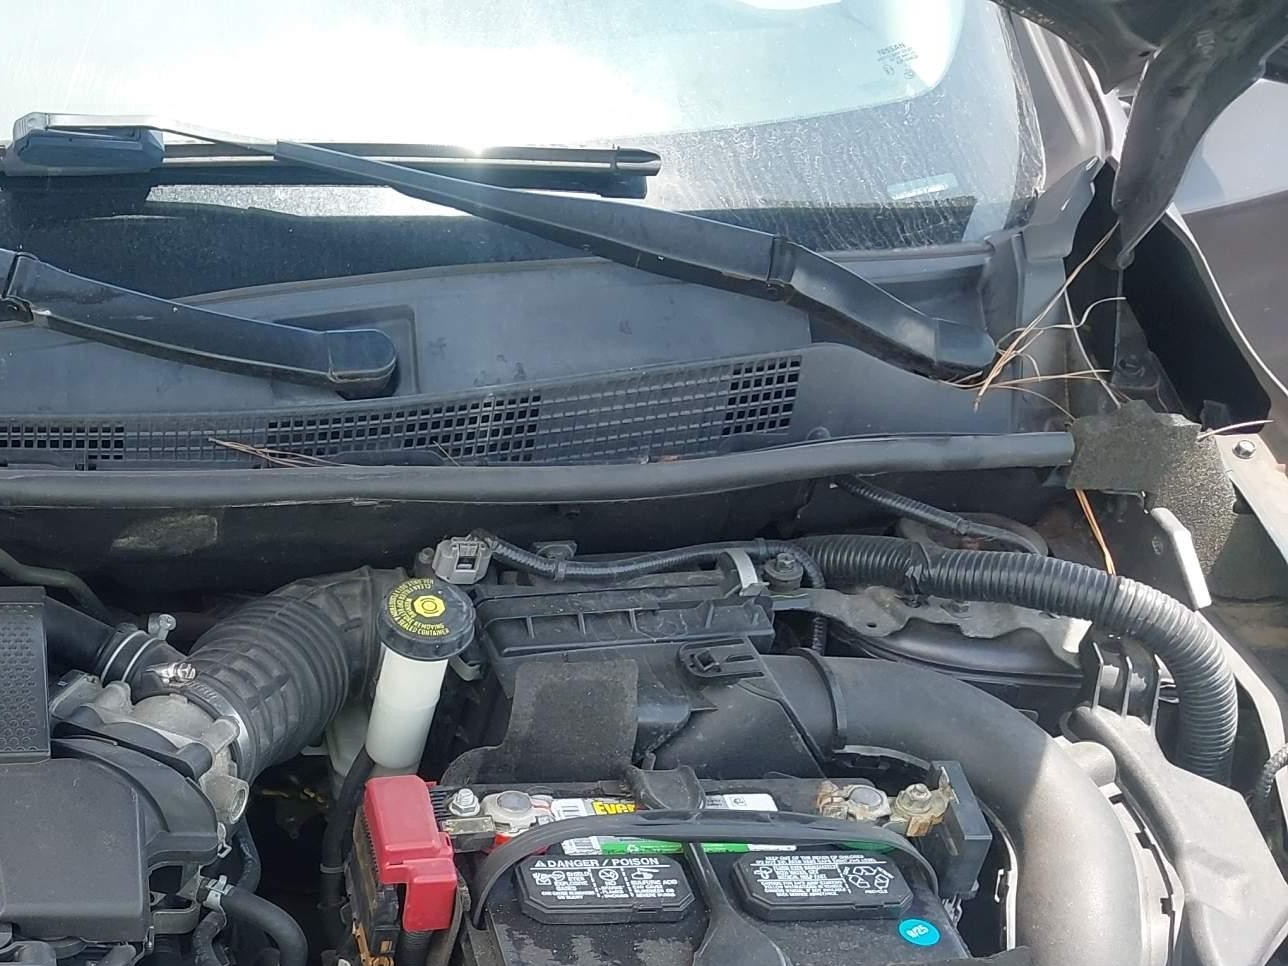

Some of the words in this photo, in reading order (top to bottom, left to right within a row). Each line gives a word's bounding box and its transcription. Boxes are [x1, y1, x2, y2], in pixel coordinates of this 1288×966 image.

[414, 621, 445, 630] REMOVING
[547, 859, 599, 868] DANGER
[612, 857, 659, 866] POISON
